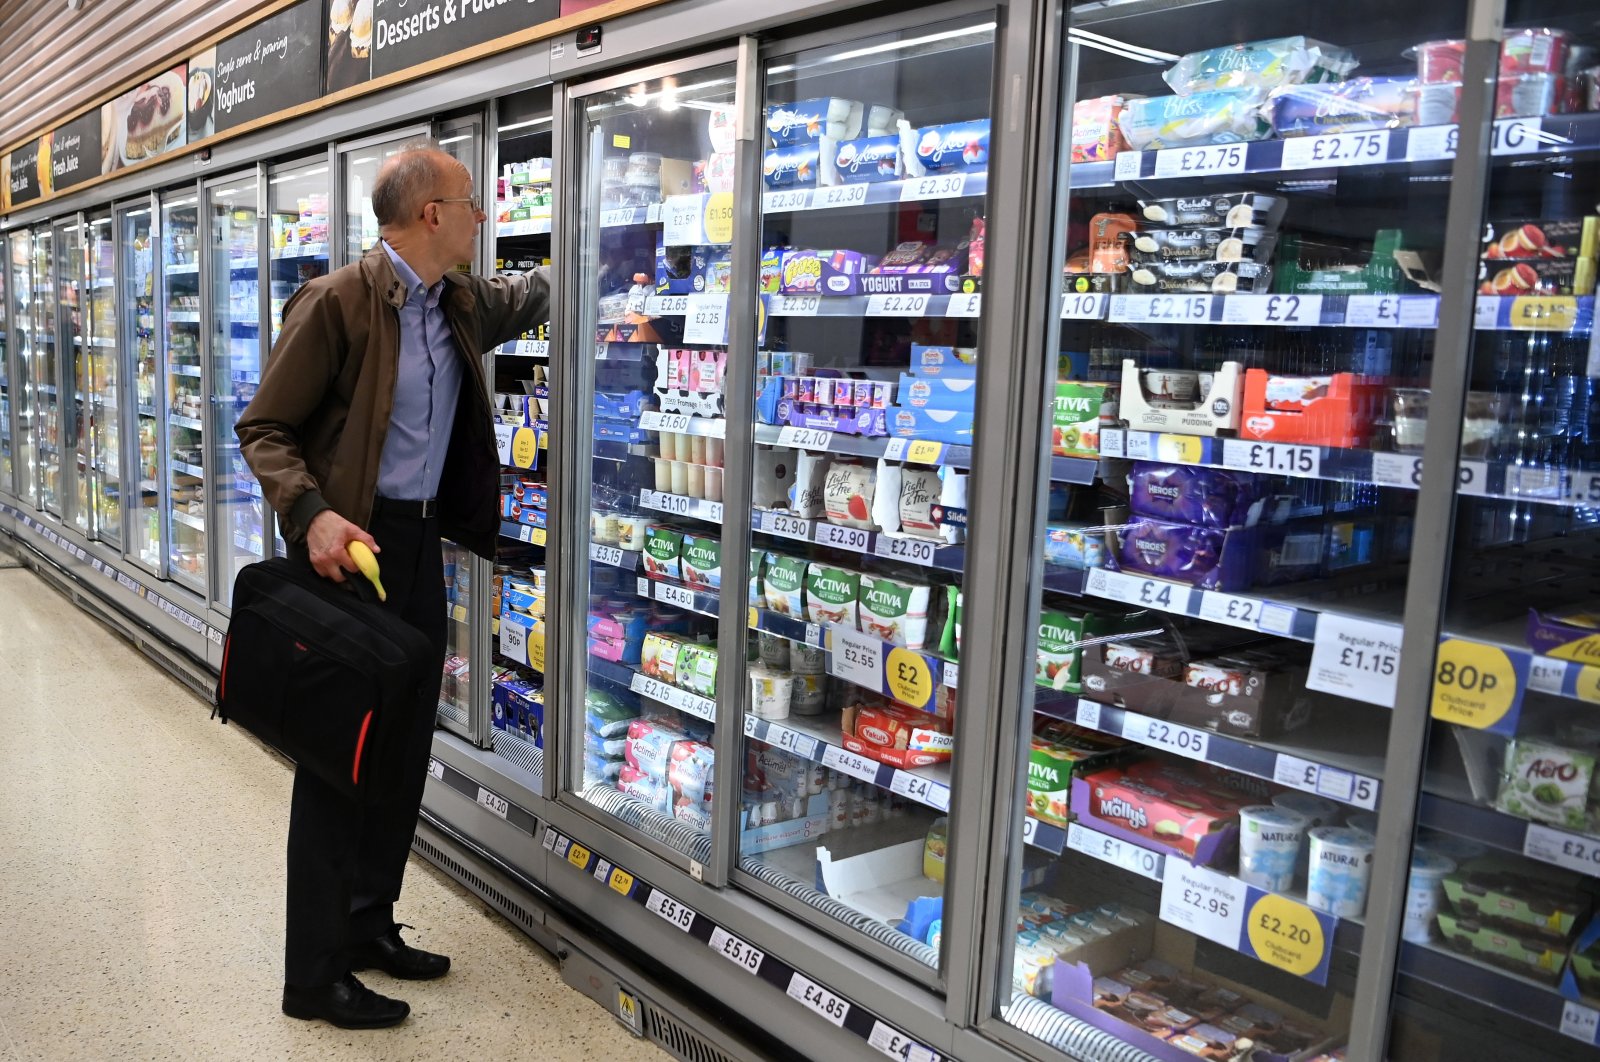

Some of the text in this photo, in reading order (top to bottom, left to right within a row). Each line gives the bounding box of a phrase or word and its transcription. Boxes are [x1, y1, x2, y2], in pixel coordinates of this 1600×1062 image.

[376, 0, 457, 50] Desserts &
[217, 35, 288, 83] Single serve & pouring
[216, 78, 256, 113] Yoghurts
[1313, 135, 1381, 160] £2.75
[53, 157, 66, 177] Fresh
[66, 154, 79, 172] Juice
[836, 143, 880, 172] Oykos
[1180, 147, 1241, 171] £2.75
[827, 186, 865, 203] £2.30
[918, 177, 962, 195] £2.30
[770, 193, 804, 208] £2.30
[710, 207, 734, 220] £1.50
[861, 276, 903, 293] YOGURT
[661, 298, 687, 311] £2.65
[782, 296, 817, 311] £2.50
[883, 296, 924, 312] £2.20
[1149, 297, 1206, 318] £2.15
[1265, 295, 1300, 322] £2
[696, 313, 719, 324] £2.25
[525, 340, 545, 354] £1.35
[1056, 397, 1091, 412] TIVIA
[659, 415, 687, 429] £1.60
[1181, 418, 1213, 427] PUDDING
[792, 431, 828, 447] £2.10
[1249, 444, 1313, 472] £1.15
[827, 471, 851, 487] Light
[902, 477, 926, 495] Light
[1148, 484, 1179, 498] HEROES
[661, 494, 687, 512] £1.10
[774, 520, 806, 536] £2.90
[830, 527, 865, 547] £2.90
[596, 546, 620, 563] £3.15
[648, 538, 674, 552] ACTIVIA
[687, 547, 716, 562] ACTIVIA
[891, 540, 930, 559] £2.90
[1135, 539, 1166, 553] HEROES
[769, 566, 797, 582] ACTIVIA
[666, 588, 692, 604] £4.60
[814, 578, 851, 596] ACTIVIA
[1140, 580, 1171, 608] £4
[866, 589, 902, 609] ACTIVIA
[508, 633, 521, 647] 90p
[1038, 624, 1076, 643] CTIVIA
[1338, 632, 1375, 648] Regular
[841, 637, 877, 656] Regular Price
[845, 648, 874, 669] £2.55
[1339, 646, 1396, 676] £1.15
[898, 662, 918, 686] £2
[1437, 660, 1498, 693] 80p
[644, 680, 670, 700] £2.15
[681, 694, 711, 715] £3.45
[1439, 692, 1486, 711] Clubcard
[1447, 704, 1474, 718] Price
[865, 729, 886, 744] Yakult
[1147, 721, 1203, 752] £2.05
[633, 741, 658, 760] Actimel
[881, 753, 903, 765] ORIGINAL
[758, 754, 787, 773] Actimel
[838, 753, 875, 775] £4.25 New
[1028, 763, 1059, 784] TIVIA
[627, 785, 654, 804] Actimel
[908, 778, 927, 797] £4
[485, 793, 507, 814] £4.20
[678, 809, 705, 830] Actimel
[1100, 799, 1148, 828] Molly's
[1181, 874, 1236, 902] Regular Price
[660, 898, 692, 927] £5.15
[1183, 888, 1229, 919] £2.95
[1260, 913, 1311, 946] £2.20
[723, 937, 760, 969] £5.15
[1264, 939, 1301, 961] Clubcard
[1271, 951, 1294, 965] Price
[803, 984, 845, 1020] £4.85
